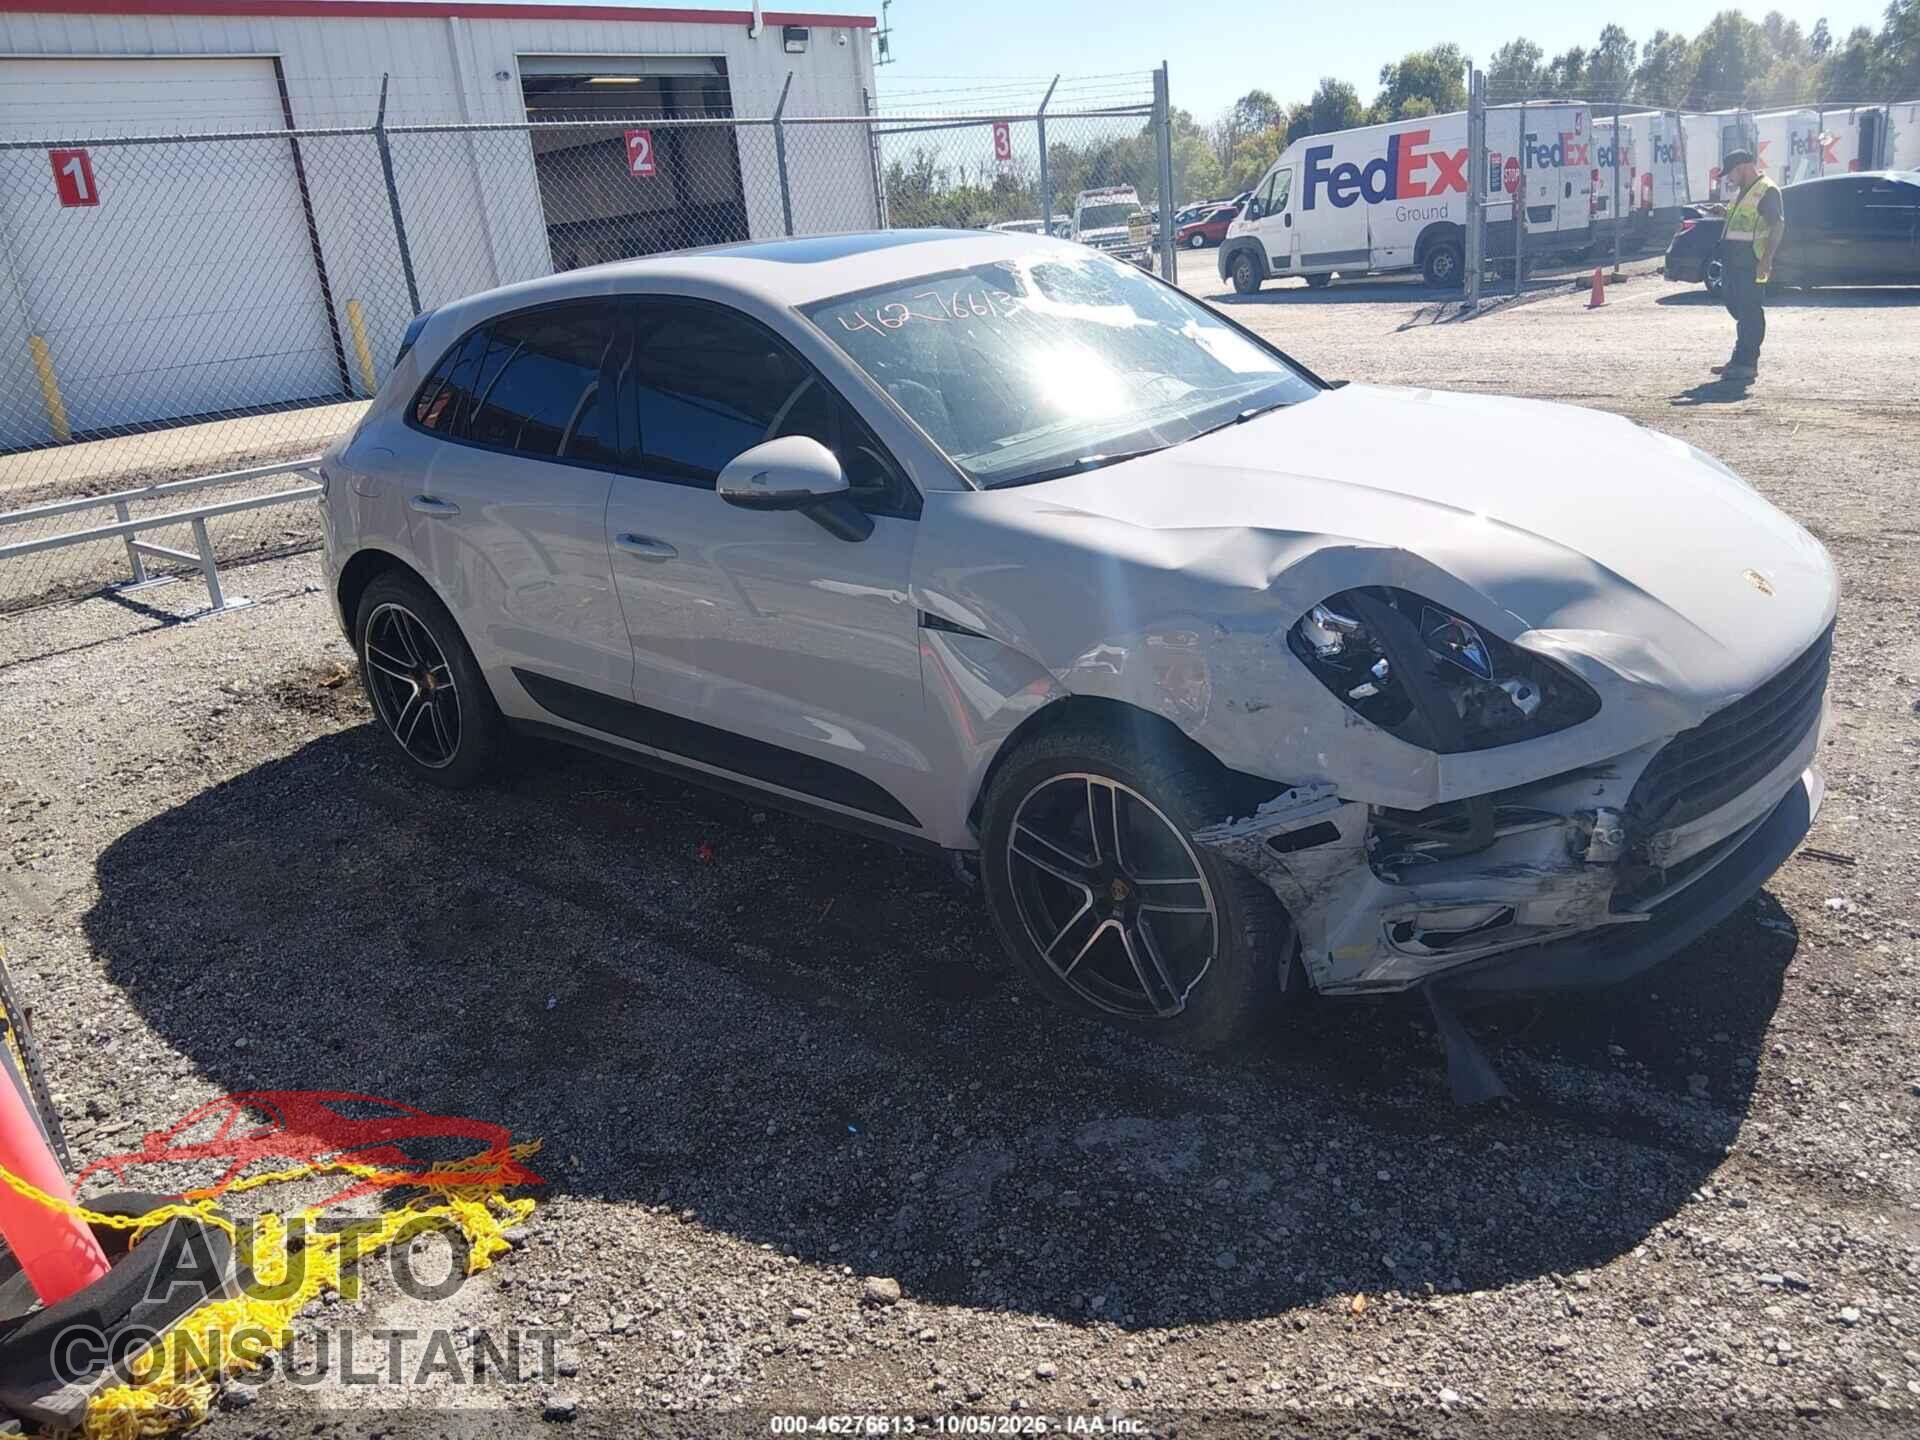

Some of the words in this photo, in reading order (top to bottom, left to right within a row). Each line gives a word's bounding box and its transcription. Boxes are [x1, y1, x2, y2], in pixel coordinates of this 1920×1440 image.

[630, 136, 652, 171] 2
[996, 127, 1009, 156] 3
[1525, 131, 1589, 169] FedEx
[63, 156, 89, 199] 1
[1302, 129, 1470, 211] FedEx
[1395, 203, 1449, 223] Ground
[837, 289, 1021, 337] 46276613
